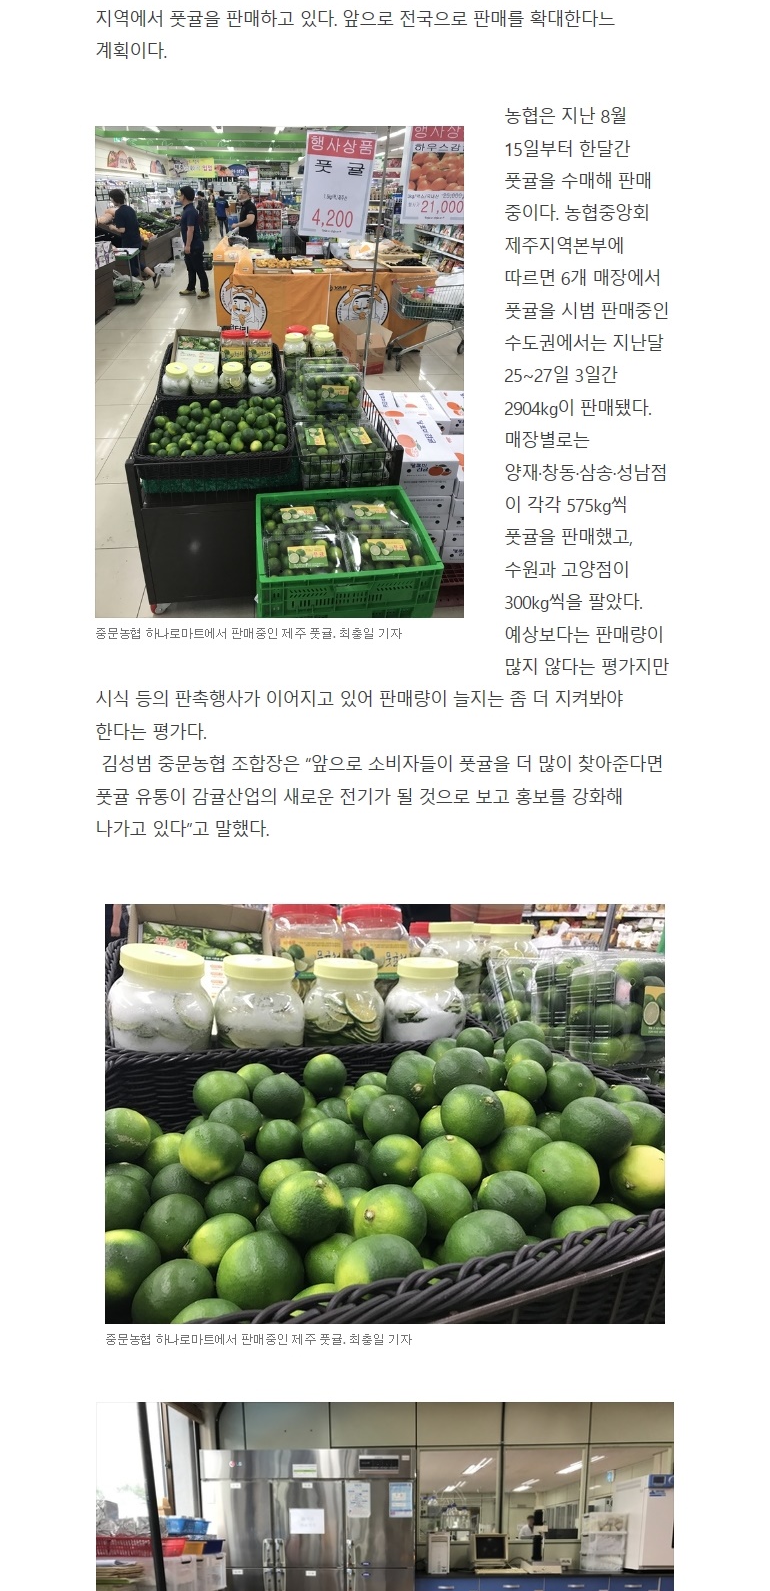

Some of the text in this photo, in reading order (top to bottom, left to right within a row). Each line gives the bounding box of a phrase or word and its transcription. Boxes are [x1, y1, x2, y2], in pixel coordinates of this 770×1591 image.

[504, 106, 626, 125] 농협은 지난 8월
[414, 126, 464, 139] 행사상
[310, 135, 374, 156] 행사상품
[414, 143, 464, 152] 하우스감
[420, 200, 464, 214] 21,000
[312, 208, 354, 228] 4,200
[504, 365, 619, 384] 25~27일 3일간
[504, 398, 652, 419] 2904kg이 판매됐다.
[505, 495, 627, 516] 이 각각 575kg씩
[95, 722, 207, 741] 한다는 평가다.
